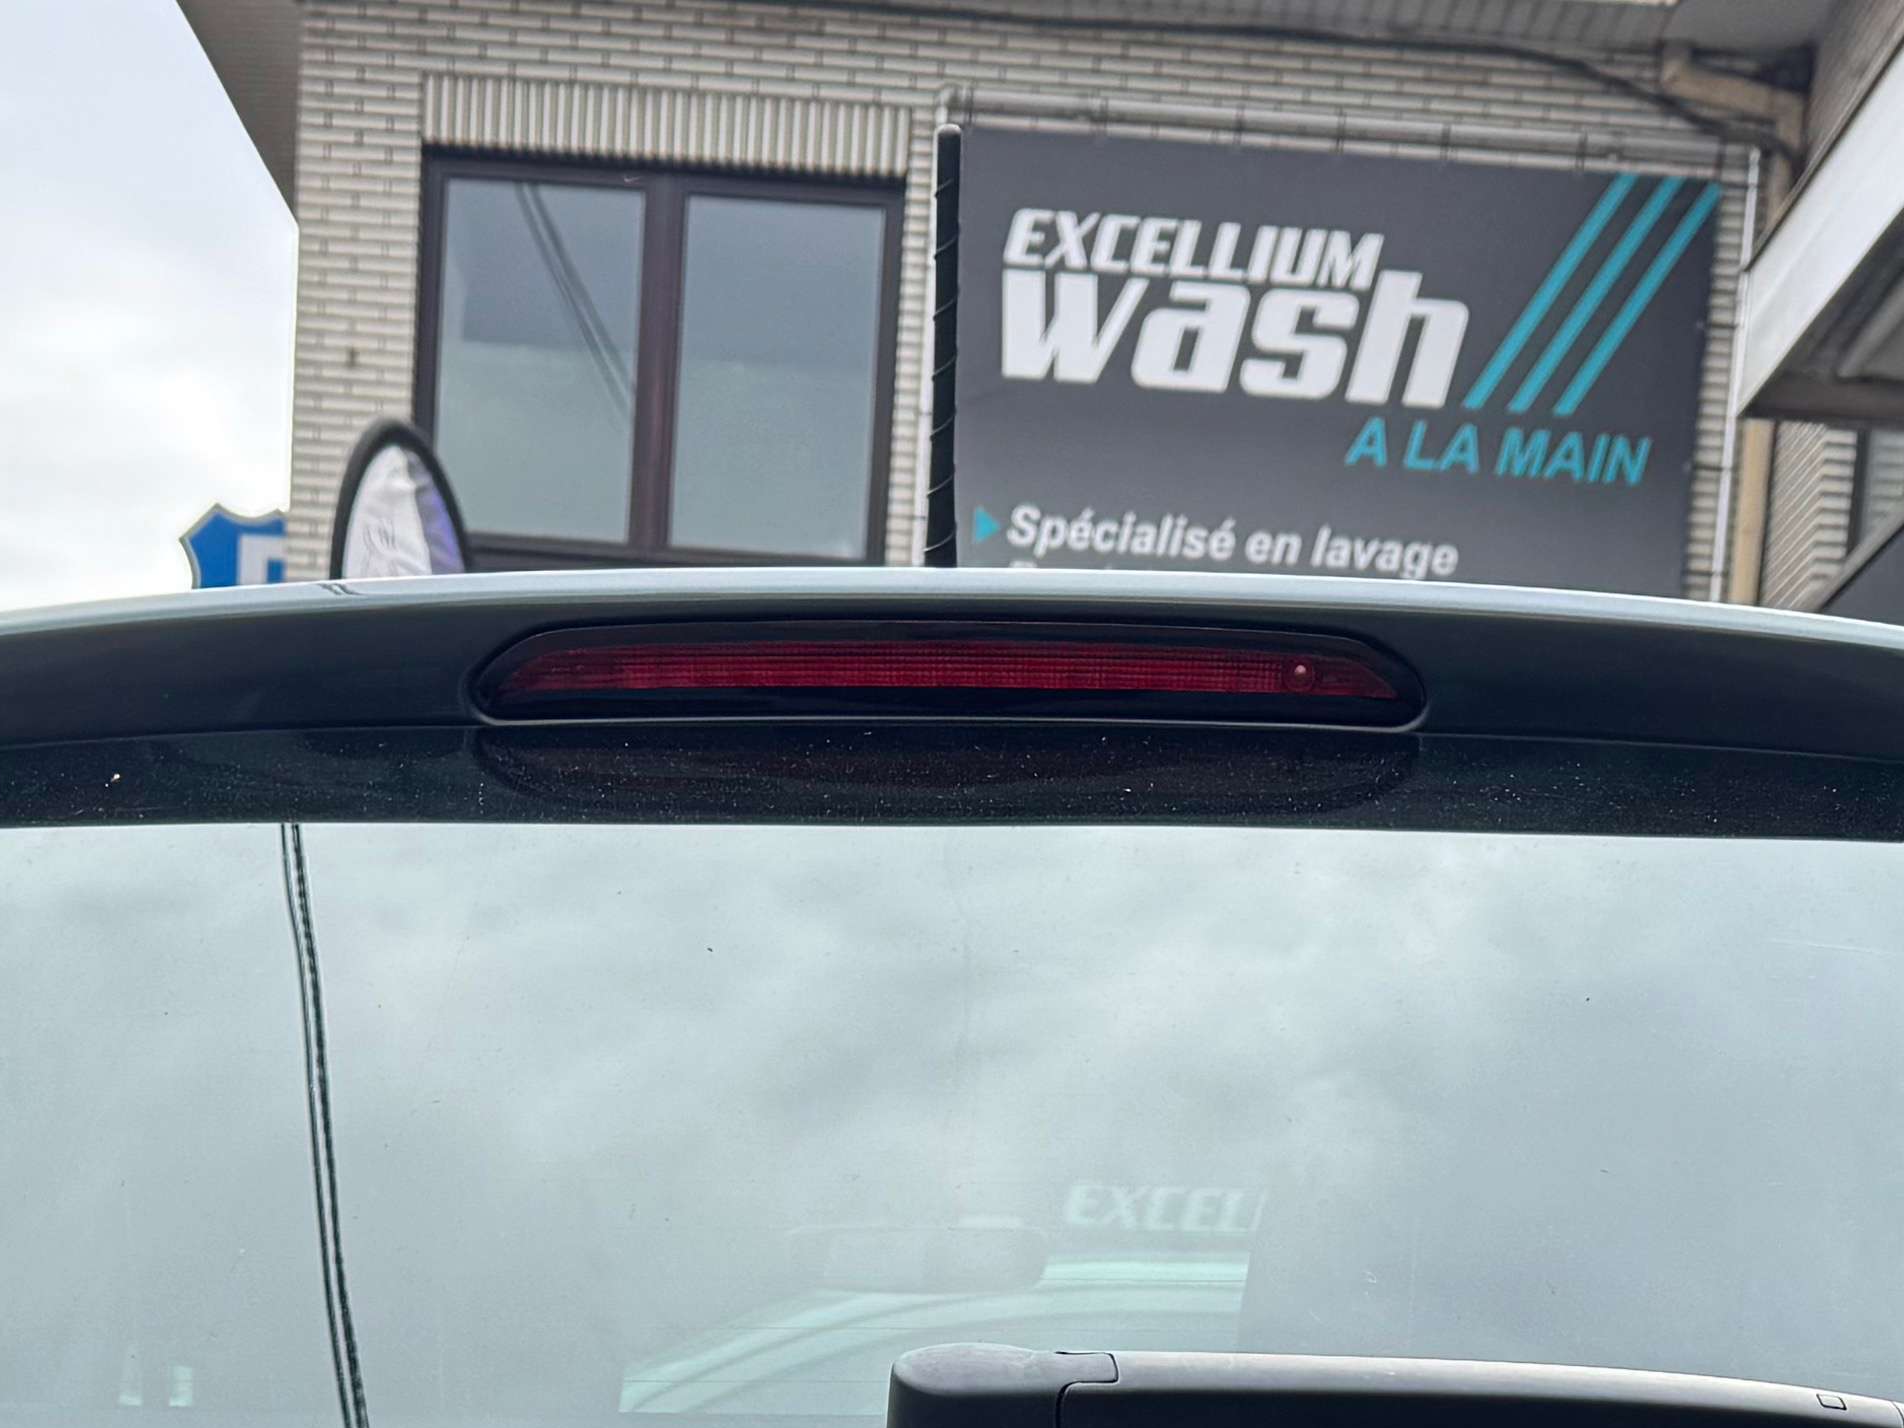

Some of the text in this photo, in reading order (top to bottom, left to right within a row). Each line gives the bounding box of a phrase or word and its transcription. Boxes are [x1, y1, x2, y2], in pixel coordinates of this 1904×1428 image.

[1003, 207, 1384, 291] EXCELLIUM
[1345, 416, 1652, 487] A LA MAIN
[1006, 504, 1459, 581] Spécialisé en lavage
